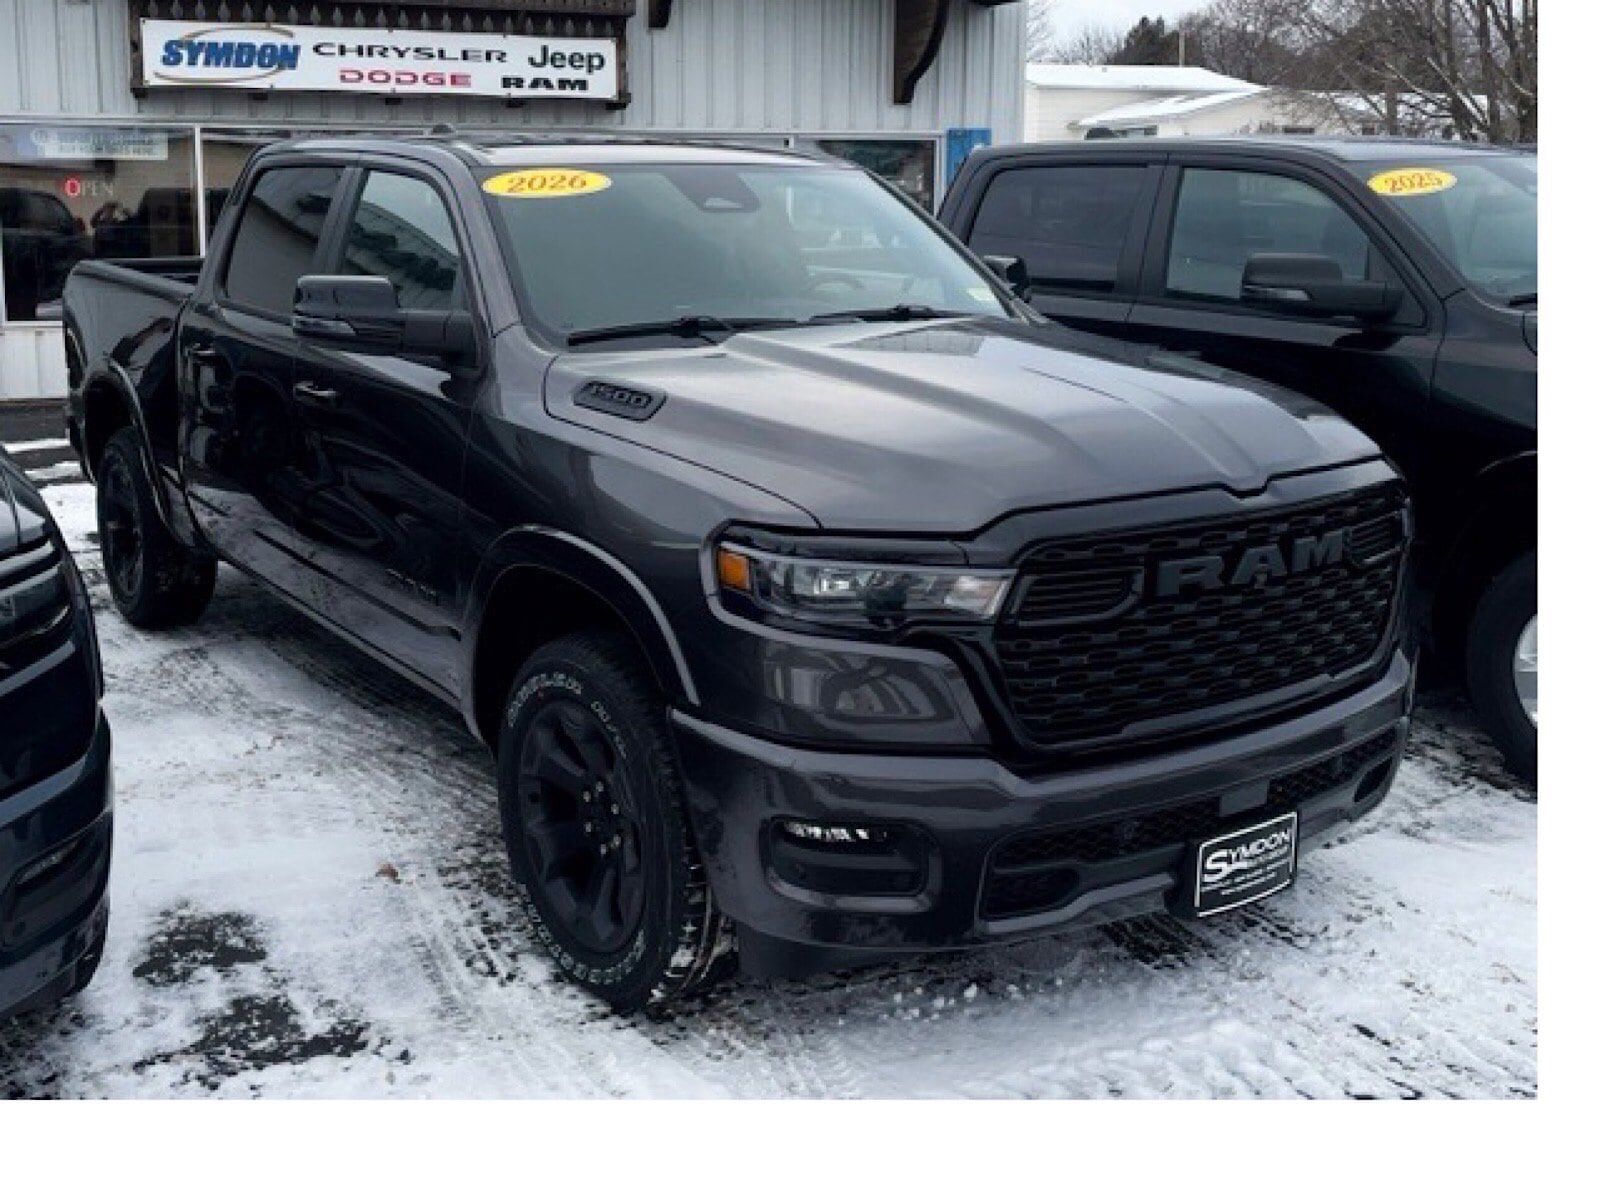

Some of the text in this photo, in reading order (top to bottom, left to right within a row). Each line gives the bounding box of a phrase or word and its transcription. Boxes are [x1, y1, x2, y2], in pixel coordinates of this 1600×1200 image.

[162, 39, 605, 72] SYMDON CHRYSLER Jeep
[340, 69, 588, 91] DODGE RAM
[507, 174, 587, 193] 2026
[1156, 528, 1343, 597] RAM
